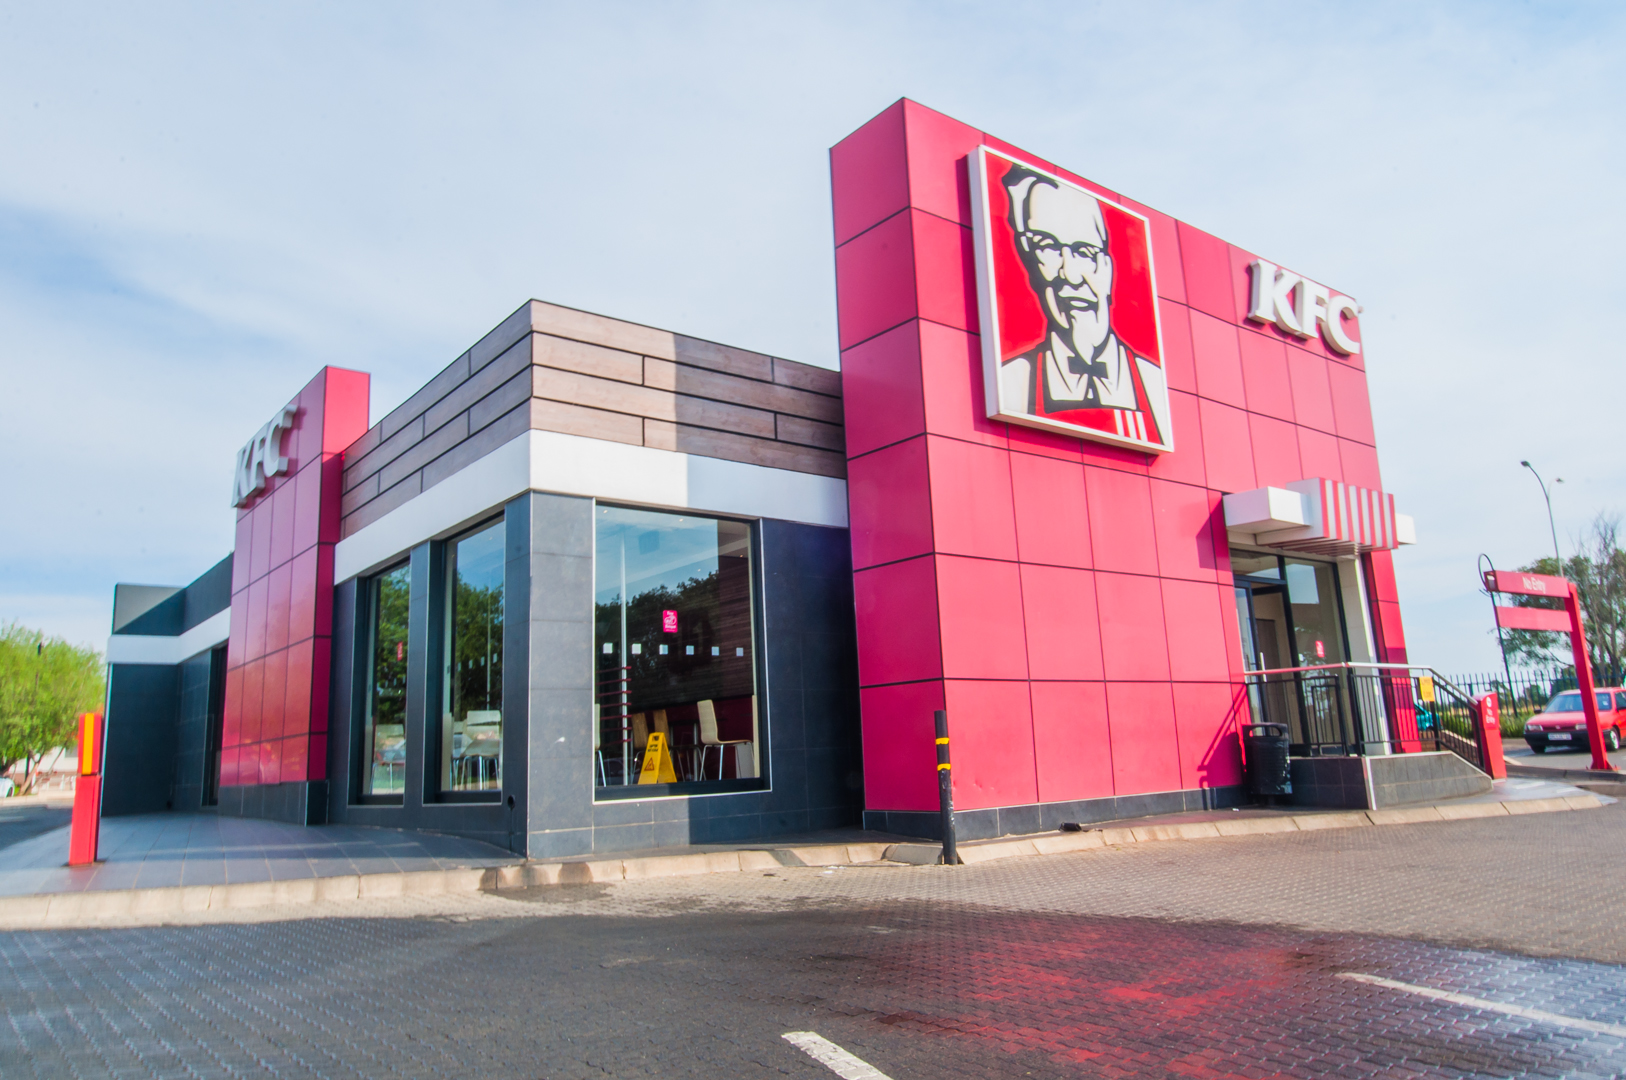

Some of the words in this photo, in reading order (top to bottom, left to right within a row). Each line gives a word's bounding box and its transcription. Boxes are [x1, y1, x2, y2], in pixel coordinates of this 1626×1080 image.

[1247, 258, 1361, 355] KFC
[231, 403, 298, 509] KFC
[1522, 575, 1533, 591] No
[1531, 576, 1546, 595] Entry
